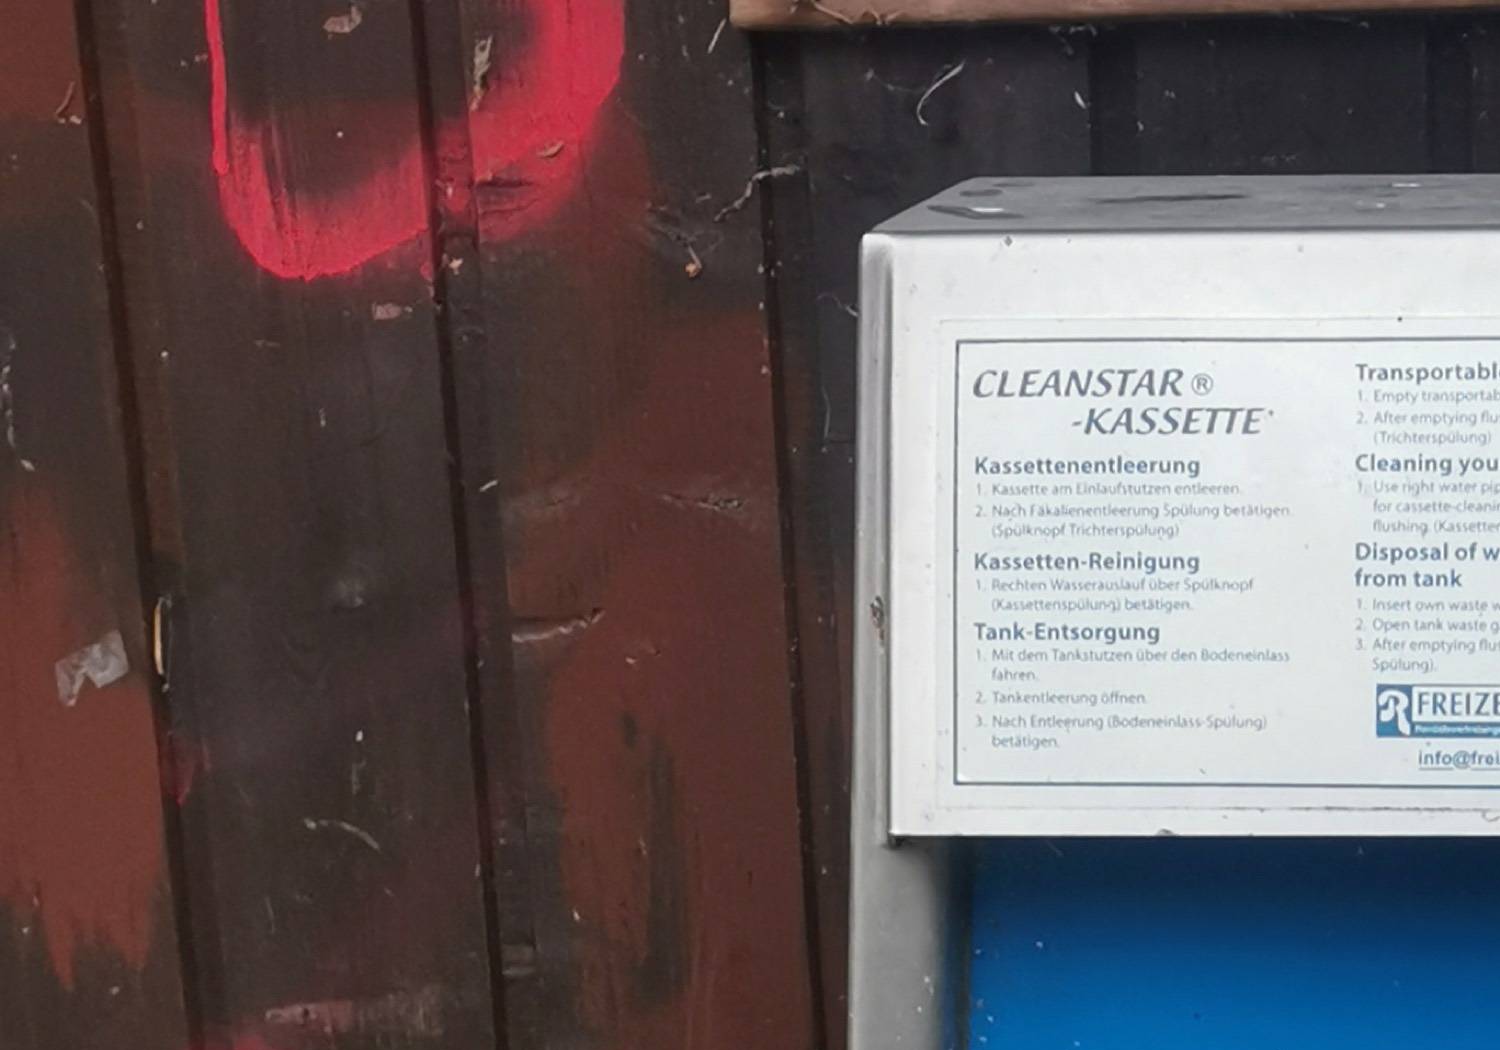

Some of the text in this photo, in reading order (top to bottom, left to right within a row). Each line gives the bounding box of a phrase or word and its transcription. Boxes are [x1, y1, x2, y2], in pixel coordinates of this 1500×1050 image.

[973, 369, 1183, 398] CLEANSTAR
[1358, 391, 1368, 402] 1.
[1374, 390, 1417, 405] Empty
[1356, 412, 1368, 425] 2.
[1374, 411, 1406, 425] After
[1410, 411, 1477, 427] emptying
[1374, 430, 1492, 446] (Trichterspülung)
[974, 456, 1200, 477] Kassettenentleerung
[1355, 453, 1451, 476] Cleaning
[976, 484, 987, 496] 1.
[992, 484, 1048, 496] Kassette
[1052, 486, 1072, 496] am
[1076, 483, 1171, 496] Einlaufstutzen
[1358, 481, 1368, 493] 1.
[1374, 481, 1398, 493] Use
[1403, 480, 1435, 496] right
[1438, 481, 1477, 493] water
[975, 506, 987, 518] 2.
[992, 504, 1025, 518] Nach
[1030, 504, 1159, 520] Fäkalienentleerung
[1163, 504, 1219, 520] Spülung
[1373, 499, 1392, 513] for
[992, 523, 1179, 540] (Spülknopf Trichterspülung)
[1355, 543, 1448, 565] Disposal
[1455, 543, 1477, 561] of
[974, 552, 1200, 574] Kassetten-Reinigung
[1354, 568, 1463, 587] from tank
[976, 578, 1254, 594] 1. Rechten Wasserauslauf über Spülknopf
[992, 598, 1121, 613] (Kassettenspülung)
[1356, 599, 1367, 611] 1.
[1373, 598, 1411, 611] Insert
[1415, 600, 1445, 611] own
[1449, 599, 1488, 611] waste
[974, 622, 1160, 644] Tank-Entsorgung
[1355, 618, 1367, 631] 2.
[1372, 618, 1410, 633] Open
[1414, 617, 1443, 631] tank
[1447, 619, 1486, 631] waste
[1355, 637, 1367, 650] 3.
[1372, 637, 1406, 651] After
[1410, 638, 1475, 654] emptying
[976, 650, 987, 662] 1.
[992, 649, 1013, 662] Mit
[1017, 649, 1048, 662] dem
[1052, 649, 1132, 662] Tankstutzen
[1136, 649, 1167, 662] über
[1171, 649, 1197, 662] den
[975, 692, 987, 704] 2.
[992, 691, 1097, 706] Tankentleerung
[975, 716, 987, 728] 3.
[992, 714, 1026, 728] Nach
[1031, 714, 1103, 731] Entleerung
